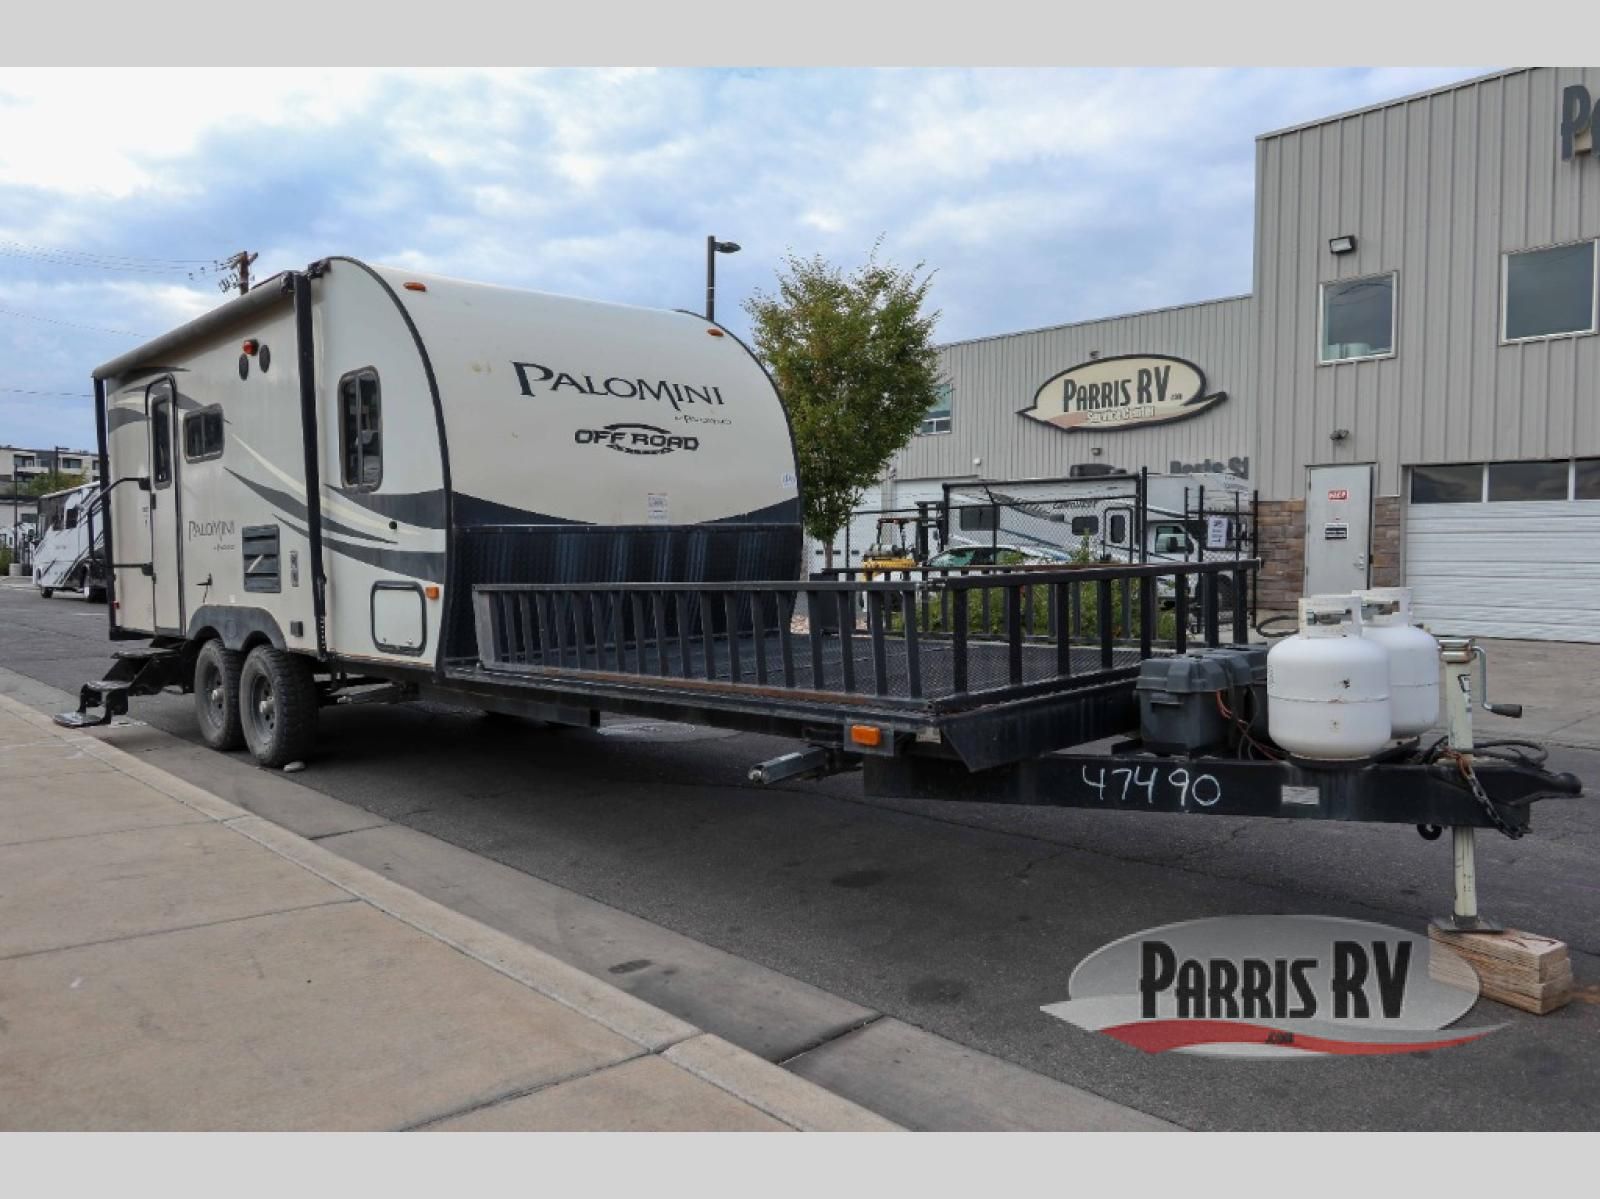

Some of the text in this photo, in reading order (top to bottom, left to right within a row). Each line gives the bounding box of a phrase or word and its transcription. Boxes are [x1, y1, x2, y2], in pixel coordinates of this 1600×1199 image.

[511, 361, 725, 412] PALOMINI
[1063, 378, 1132, 413] PARRIS
[1137, 364, 1172, 404] RV
[574, 428, 700, 451] OFF ROAD
[188, 519, 236, 542] PALOMINI
[1082, 764, 1222, 807] 47490
